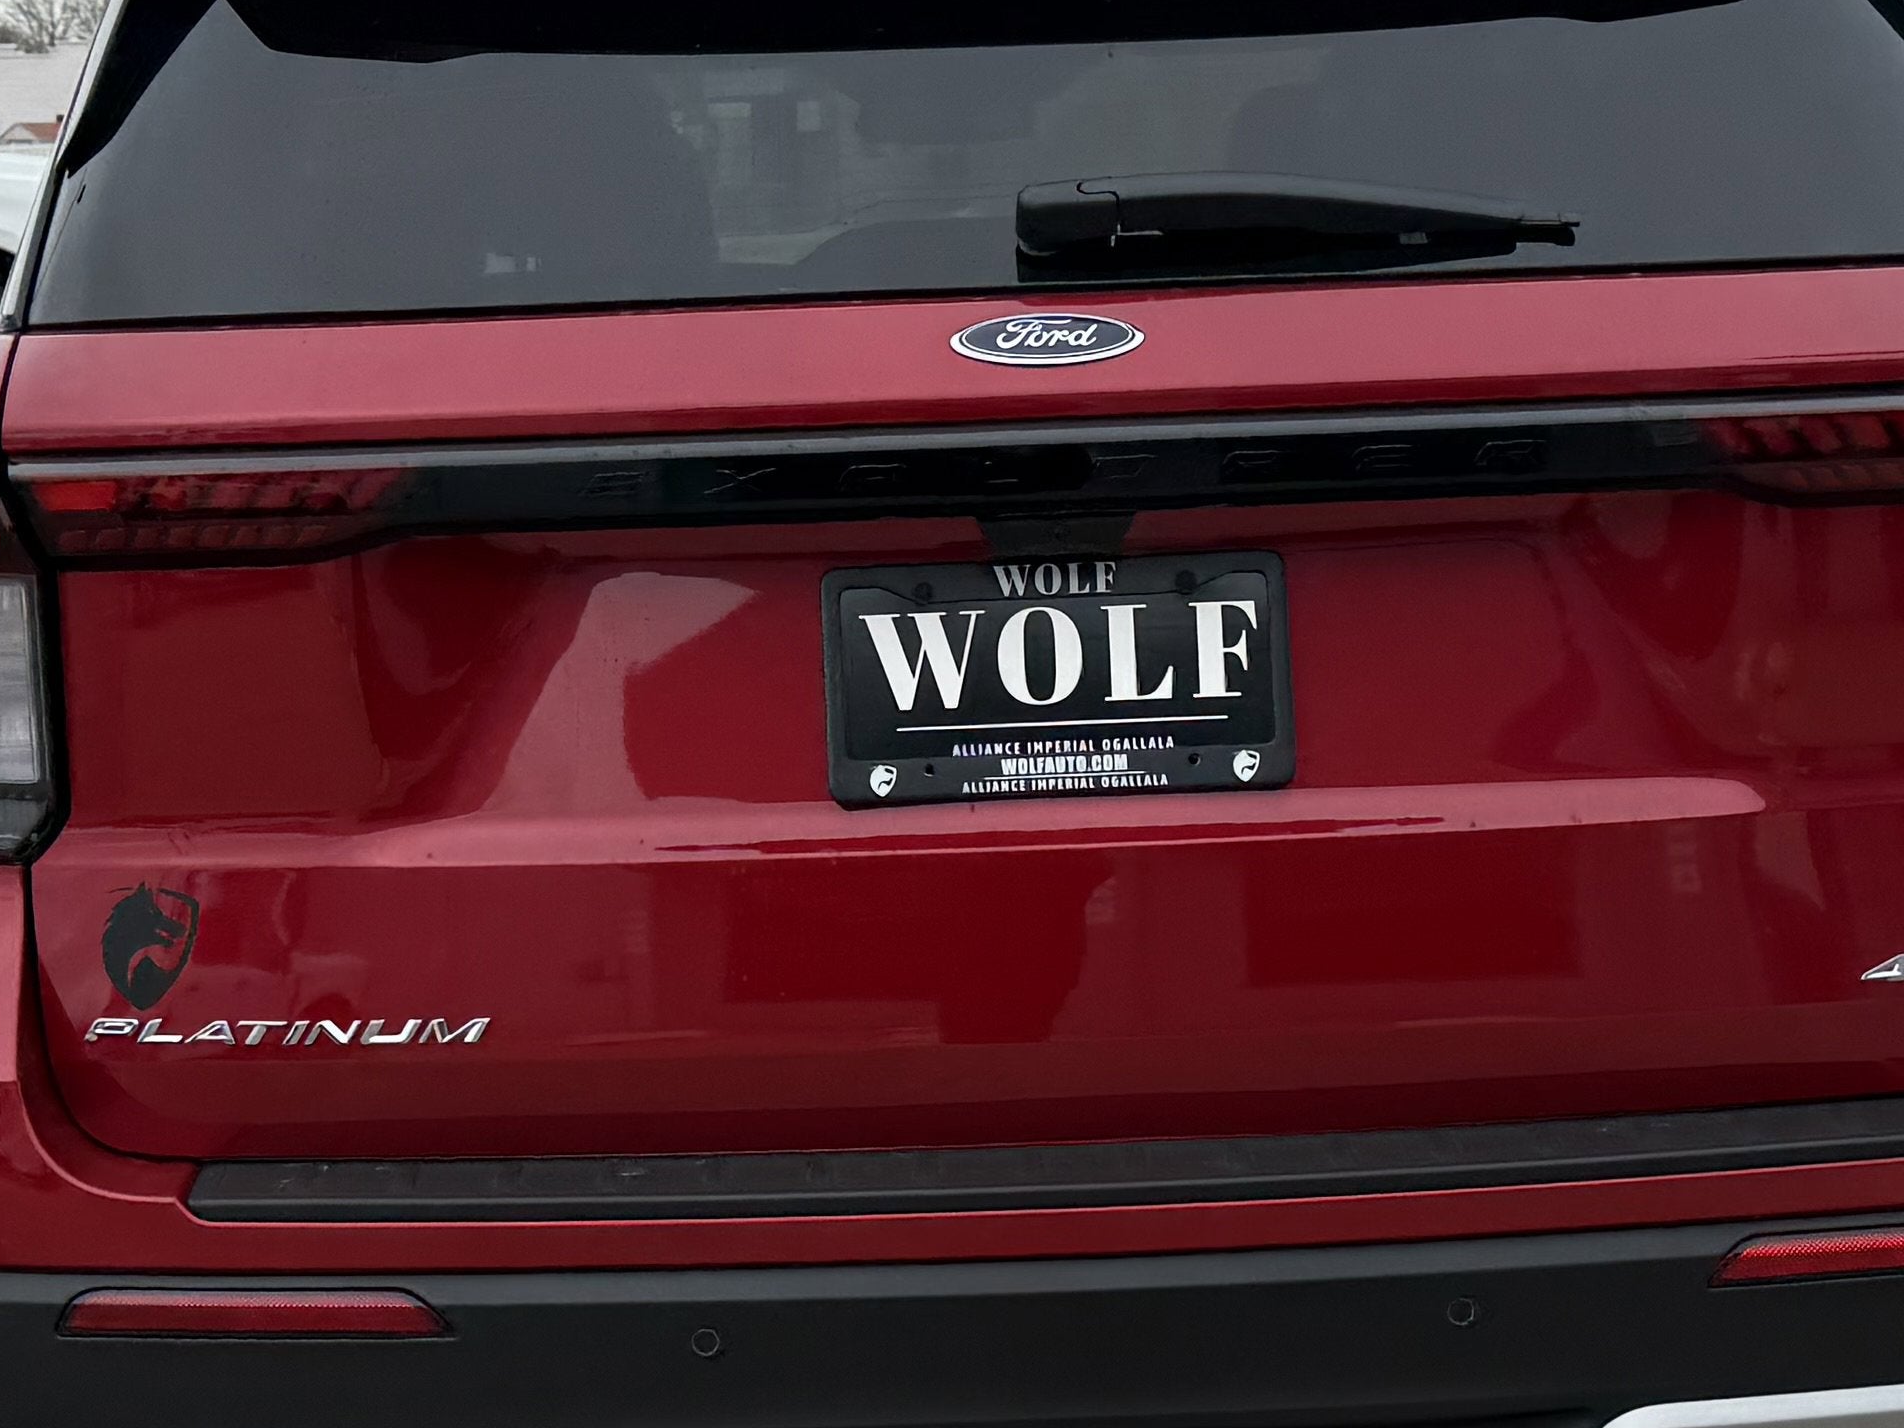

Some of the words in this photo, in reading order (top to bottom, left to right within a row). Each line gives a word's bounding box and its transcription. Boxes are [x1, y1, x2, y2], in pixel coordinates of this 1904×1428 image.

[995, 318, 1098, 349] Ford
[993, 561, 1117, 597] WOLF
[858, 600, 1258, 712] WOLF
[952, 742, 1021, 757] ALLIANCE
[1027, 740, 1095, 755] IMPERIAL
[1101, 735, 1174, 751] OGALLALA
[1000, 753, 1129, 776] WOLFAUTO.COM
[961, 780, 1026, 795] ALLIANCE
[1031, 777, 1095, 792] IMPERIAL
[1100, 773, 1169, 789] OGALLALA
[84, 1017, 492, 1047] PLATINUM
